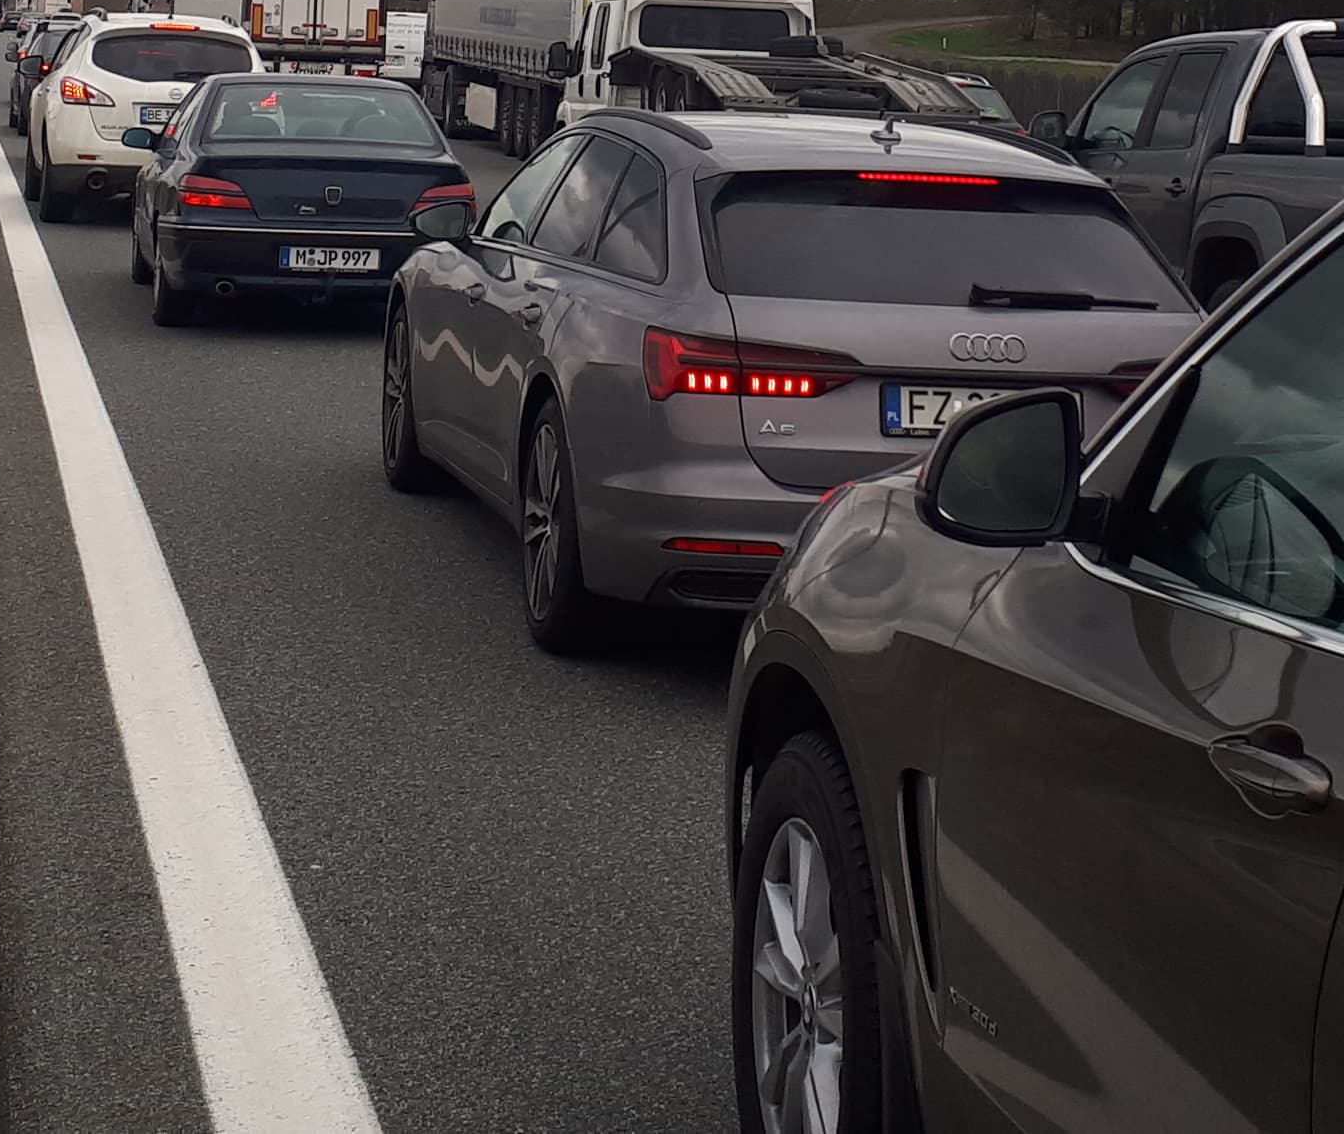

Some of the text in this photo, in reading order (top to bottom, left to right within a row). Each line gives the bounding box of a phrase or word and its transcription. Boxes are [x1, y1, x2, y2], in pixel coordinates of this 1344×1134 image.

[296, 249, 371, 266] M JP 997
[908, 390, 951, 425] FZ
